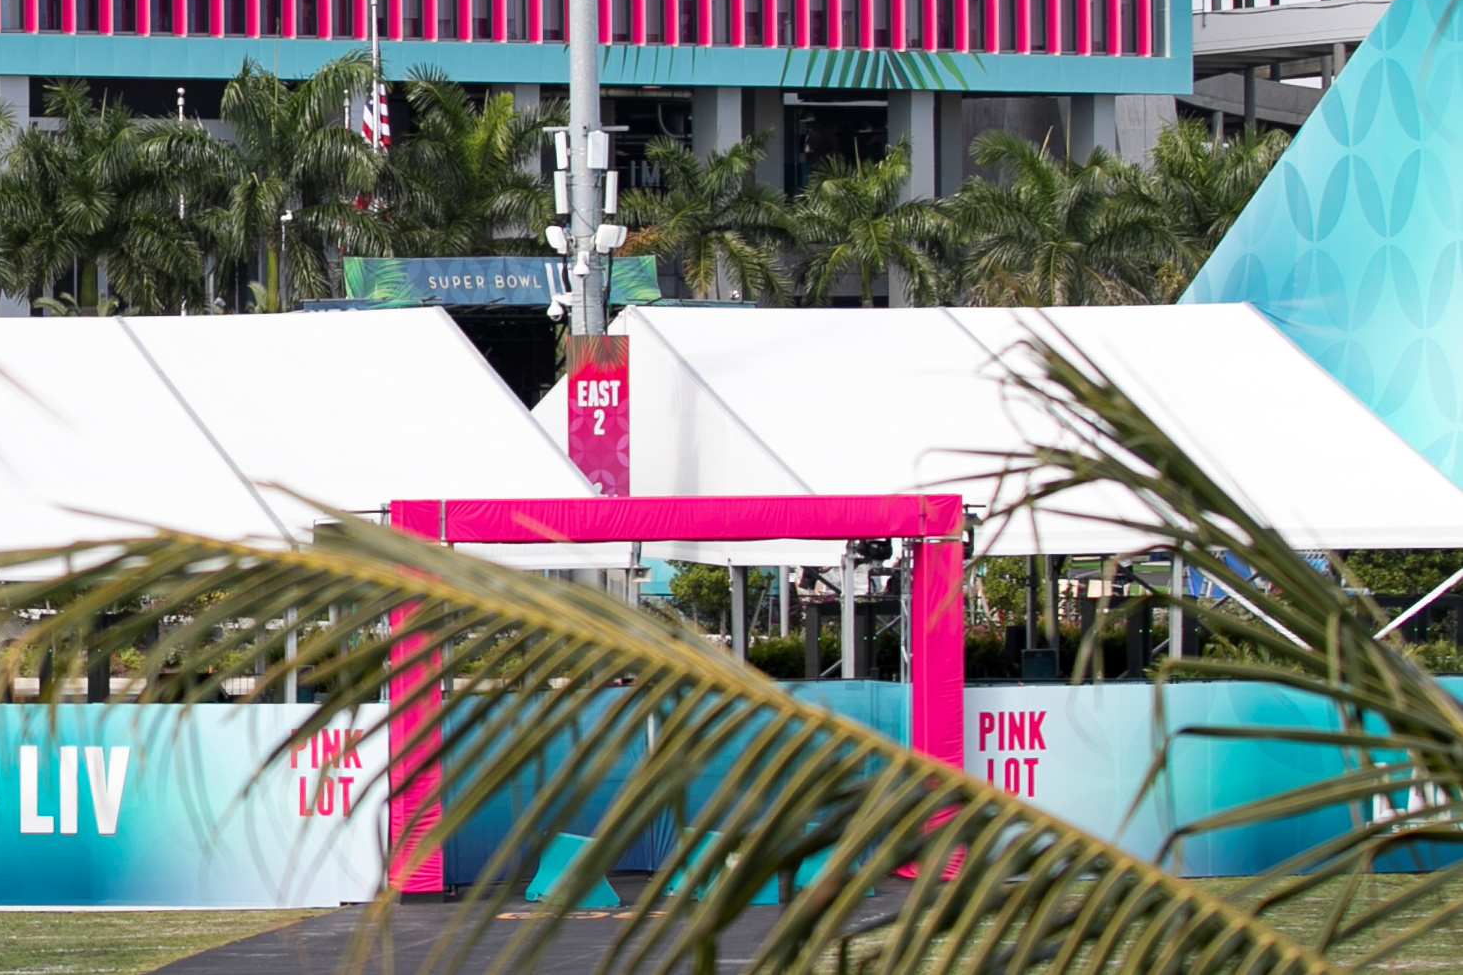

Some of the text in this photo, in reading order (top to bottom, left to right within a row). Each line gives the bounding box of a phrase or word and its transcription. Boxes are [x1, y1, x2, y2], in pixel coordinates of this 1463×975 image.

[428, 275, 485, 289] SUPER
[494, 275, 543, 288] BOWL
[577, 380, 621, 407] EAST
[593, 408, 606, 435] 2
[290, 728, 364, 769] PINK
[979, 711, 1047, 752] PINK
[19, 745, 131, 835] LIV
[299, 776, 355, 817] LOT
